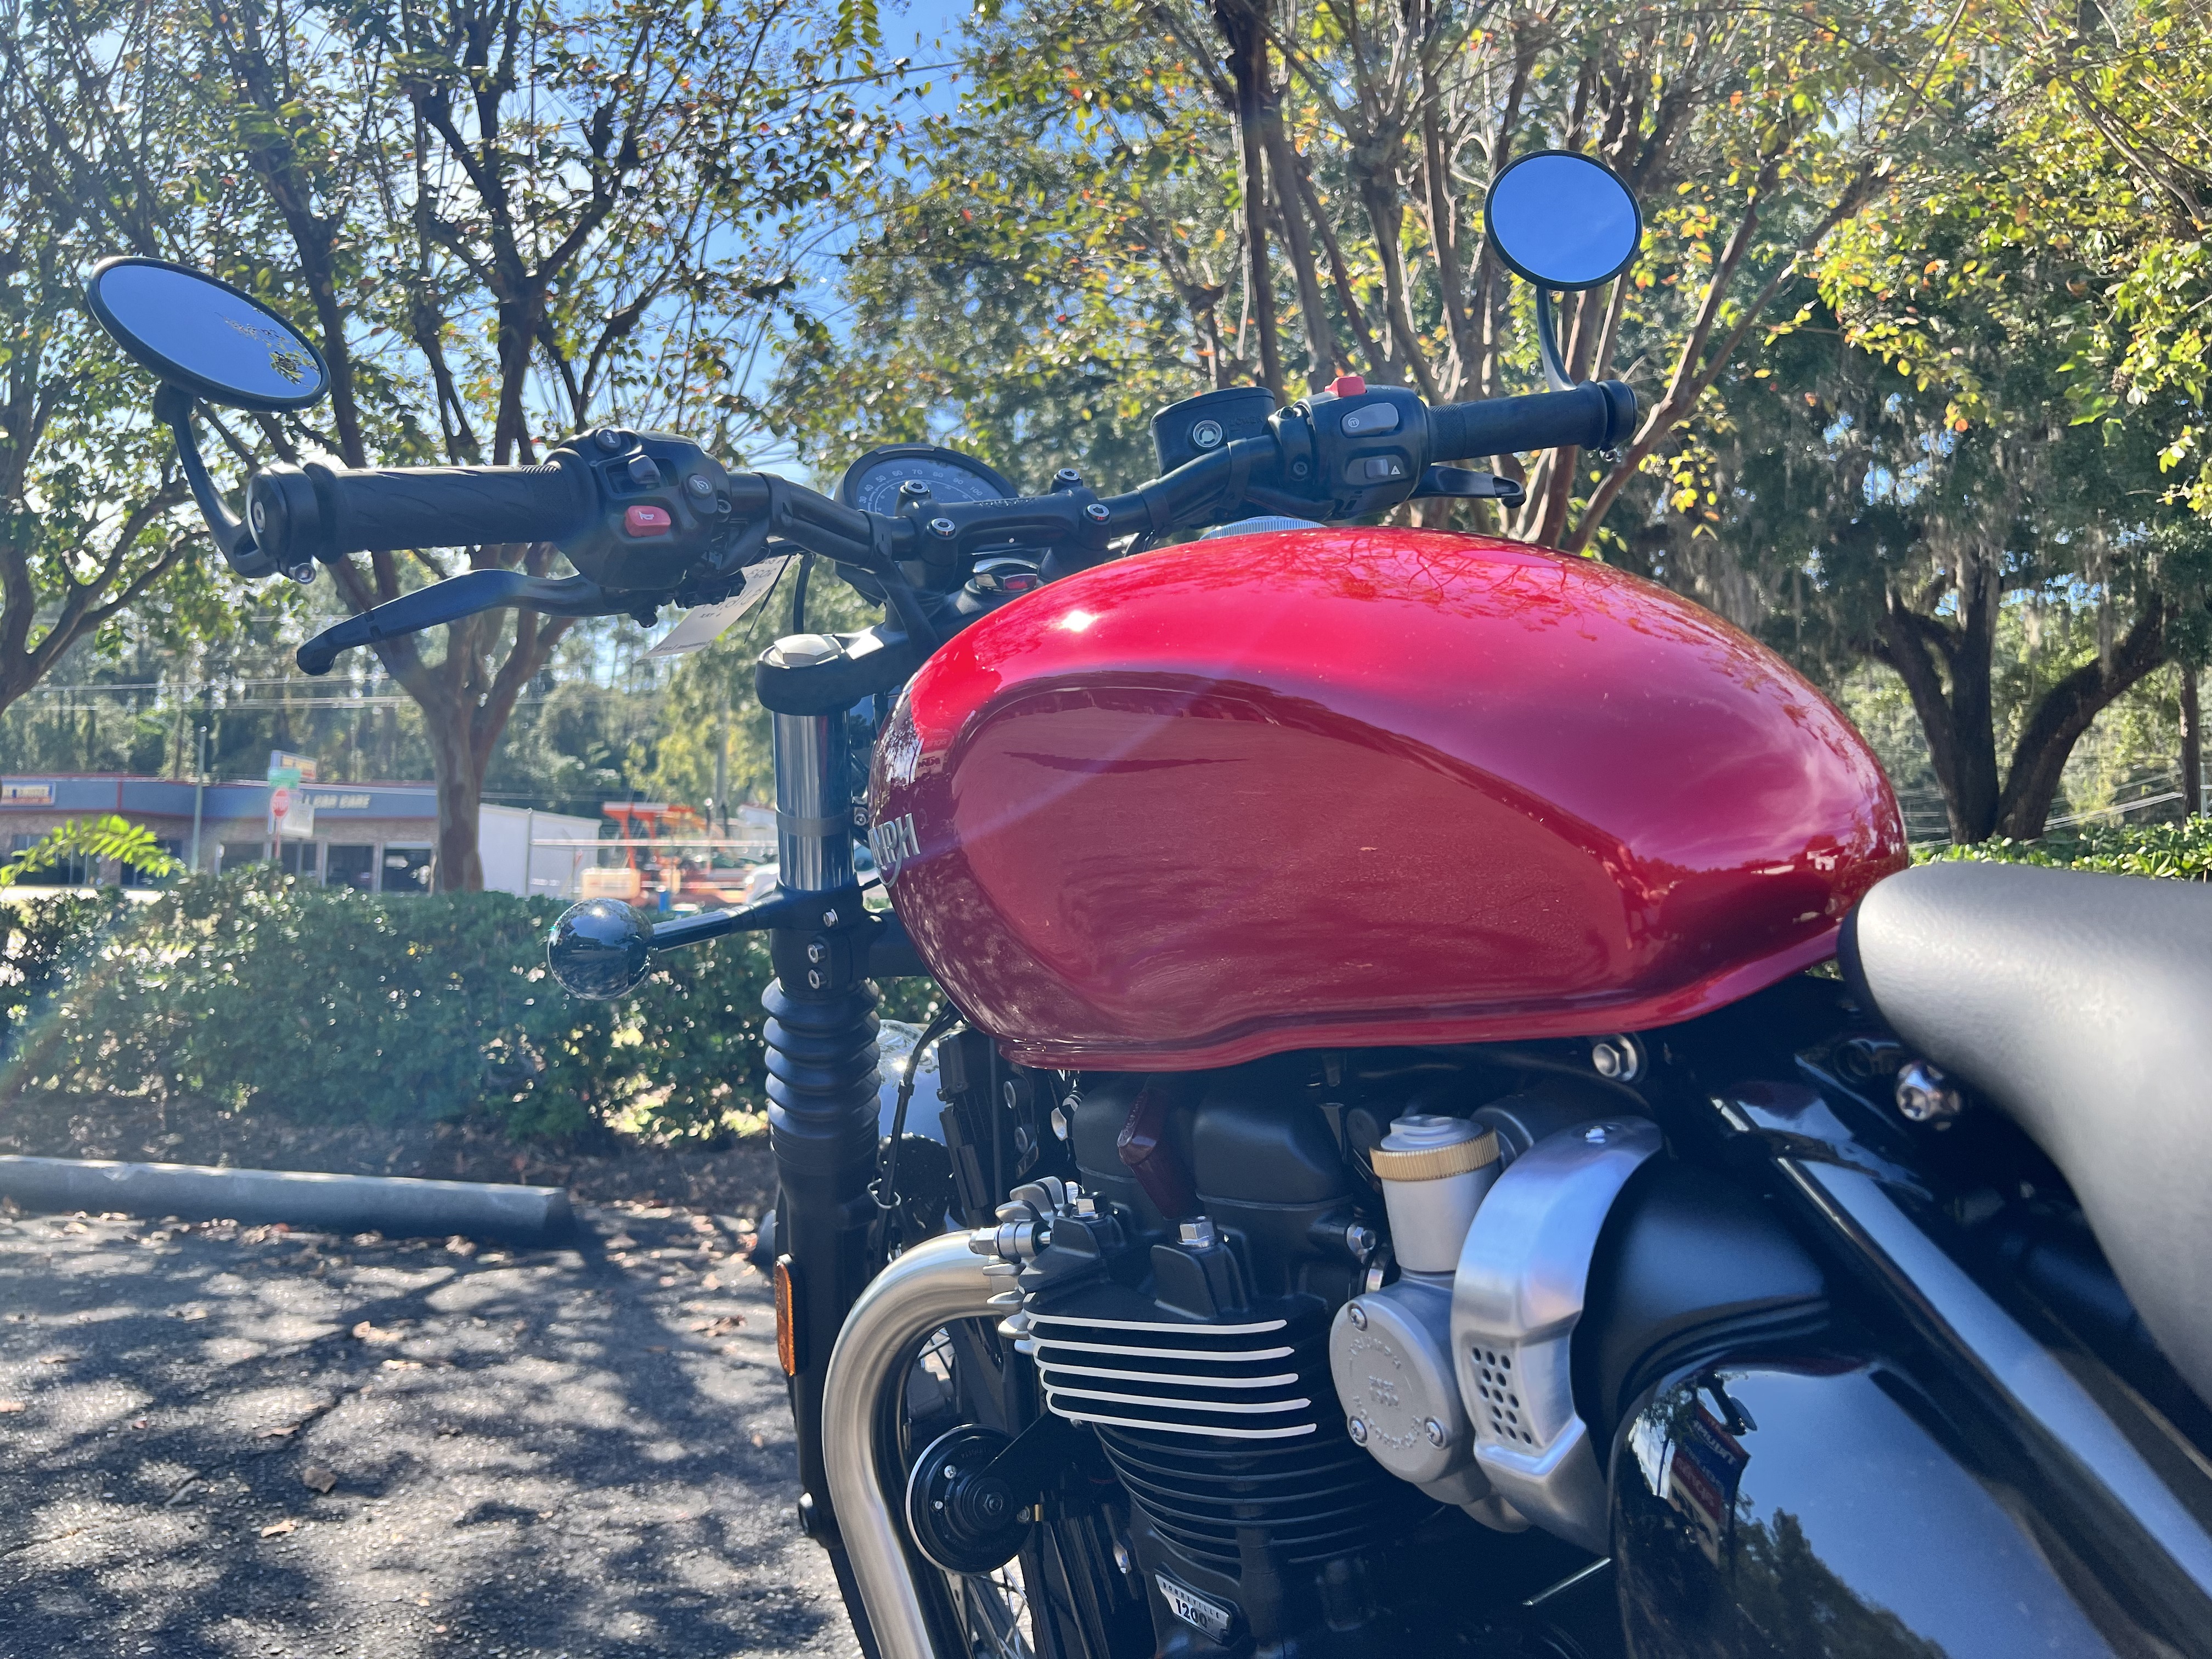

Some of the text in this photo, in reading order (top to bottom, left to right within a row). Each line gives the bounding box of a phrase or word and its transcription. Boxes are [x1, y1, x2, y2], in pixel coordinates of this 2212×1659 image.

[952, 477, 964, 486] 90
[864, 484, 874, 493] 40
[969, 486, 984, 496] 100
[859, 495, 867, 504] 30
[1175, 1598, 1208, 1628] 1200
